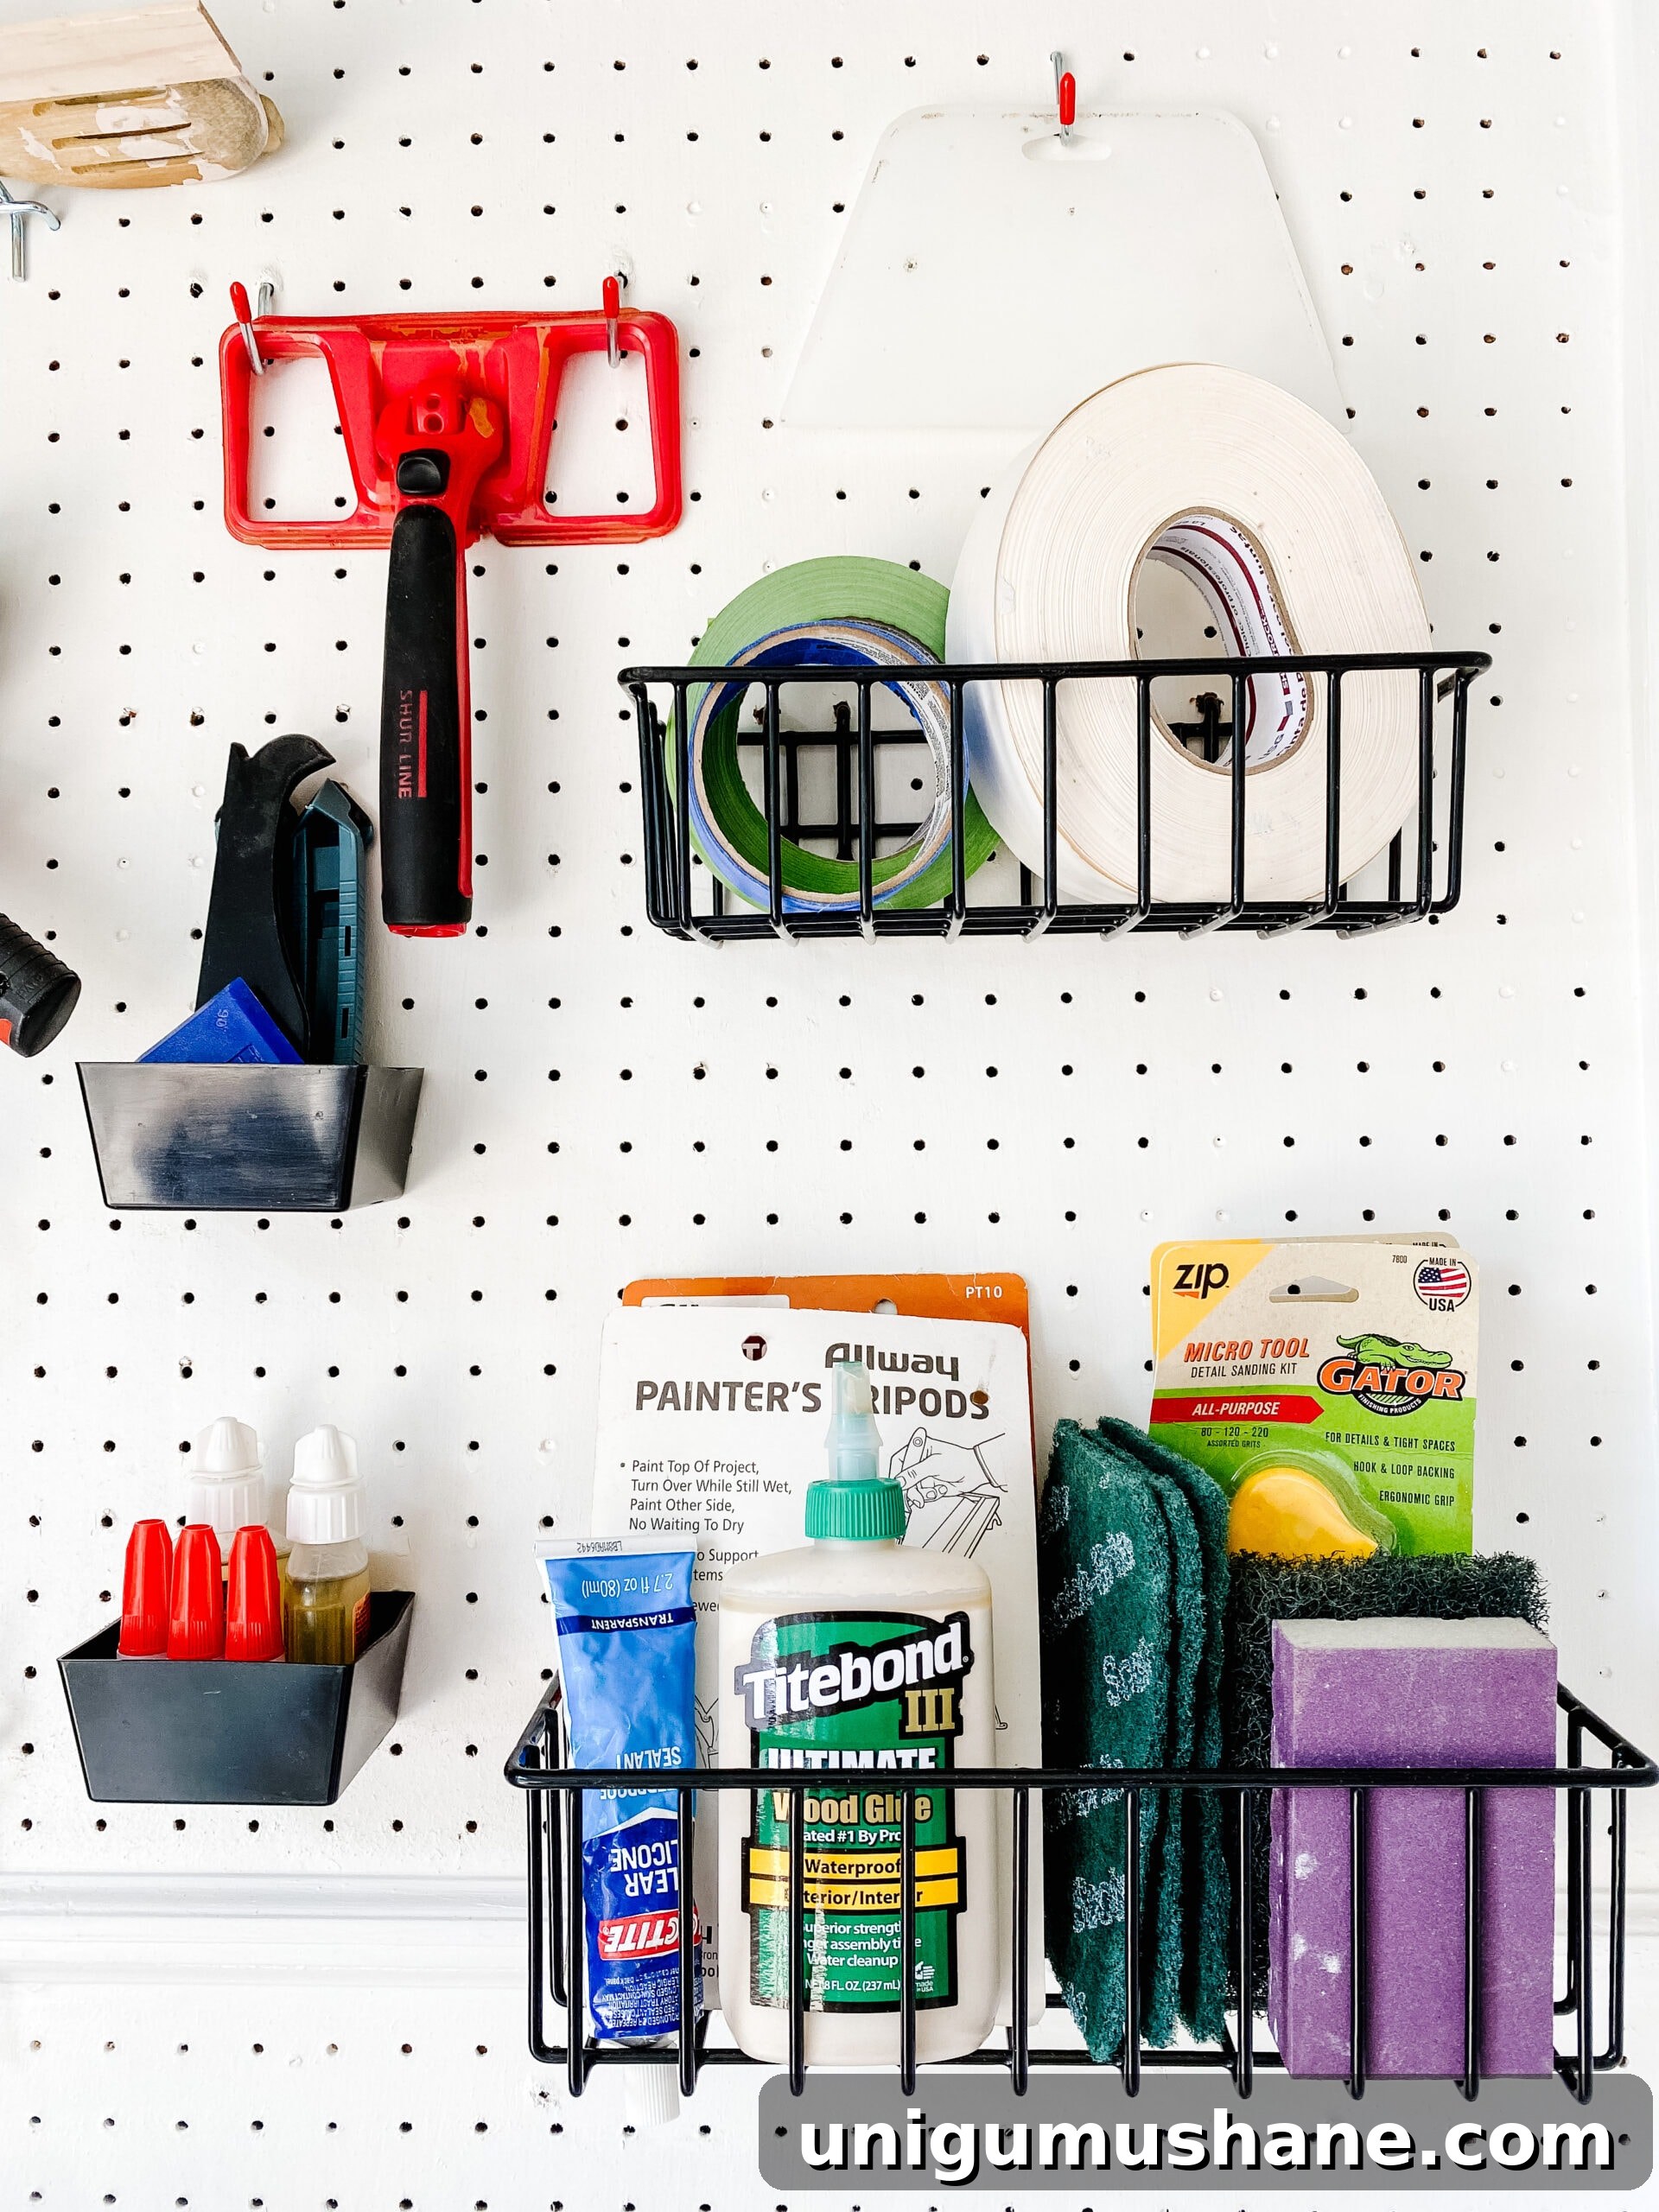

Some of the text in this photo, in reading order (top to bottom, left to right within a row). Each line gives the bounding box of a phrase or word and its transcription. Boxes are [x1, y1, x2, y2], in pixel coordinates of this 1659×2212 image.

[1429, 1257, 1457, 1267] MADE IN
[965, 1286, 1002, 1299] PT10
[1428, 1298, 1455, 1313] USA
[1184, 1338, 1310, 1363] MICRO TOOL
[824, 1342, 959, 1382] Allway
[1191, 1363, 1298, 1378] DETAIL SANDING KIT
[1319, 1357, 1463, 1398] GATOR
[870, 1385, 989, 1421] RIPODS
[1192, 1402, 1281, 1416] ALL-PURPOSE
[1357, 1394, 1422, 1414] FINISHING PRODUCTS
[1201, 1427, 1212, 1437] 80
[1224, 1427, 1240, 1437] 120
[1251, 1427, 1268, 1438] 220
[1207, 1440, 1261, 1448] ASSORTED GRITS
[1325, 1432, 1456, 1452] FOR DETAILS & TIGHT SPACES
[632, 1459, 760, 1476] Paint Top Of Project,
[1353, 1461, 1455, 1479] HOOK & LOOP BACKING
[632, 1479, 791, 1495] Turn Over While Still Wet,
[630, 1498, 735, 1513] Paint Other Side,
[1379, 1491, 1455, 1506] ERGONOMIC GRIP
[629, 1518, 744, 1534] No Waiting To Dry
[696, 1551, 705, 1561] o
[694, 1568, 723, 1581] tems
[582, 1573, 673, 1599] 2.7 fl oz (80ml)
[591, 1612, 674, 1630] TRANSPARENT
[742, 1621, 963, 1719] Titebond
[804, 1828, 901, 1846] ated #1 By Pro
[804, 1859, 901, 1878] Waterproof
[625, 1868, 678, 1897] LEAR
[854, 1921, 901, 1936] strengt
[830, 1937, 891, 1953] assembly
[893, 1936, 922, 1948] tie
[847, 1954, 899, 1968] cleanup
[862, 1980, 882, 1992] (237
[883, 1980, 901, 1991] mL)
